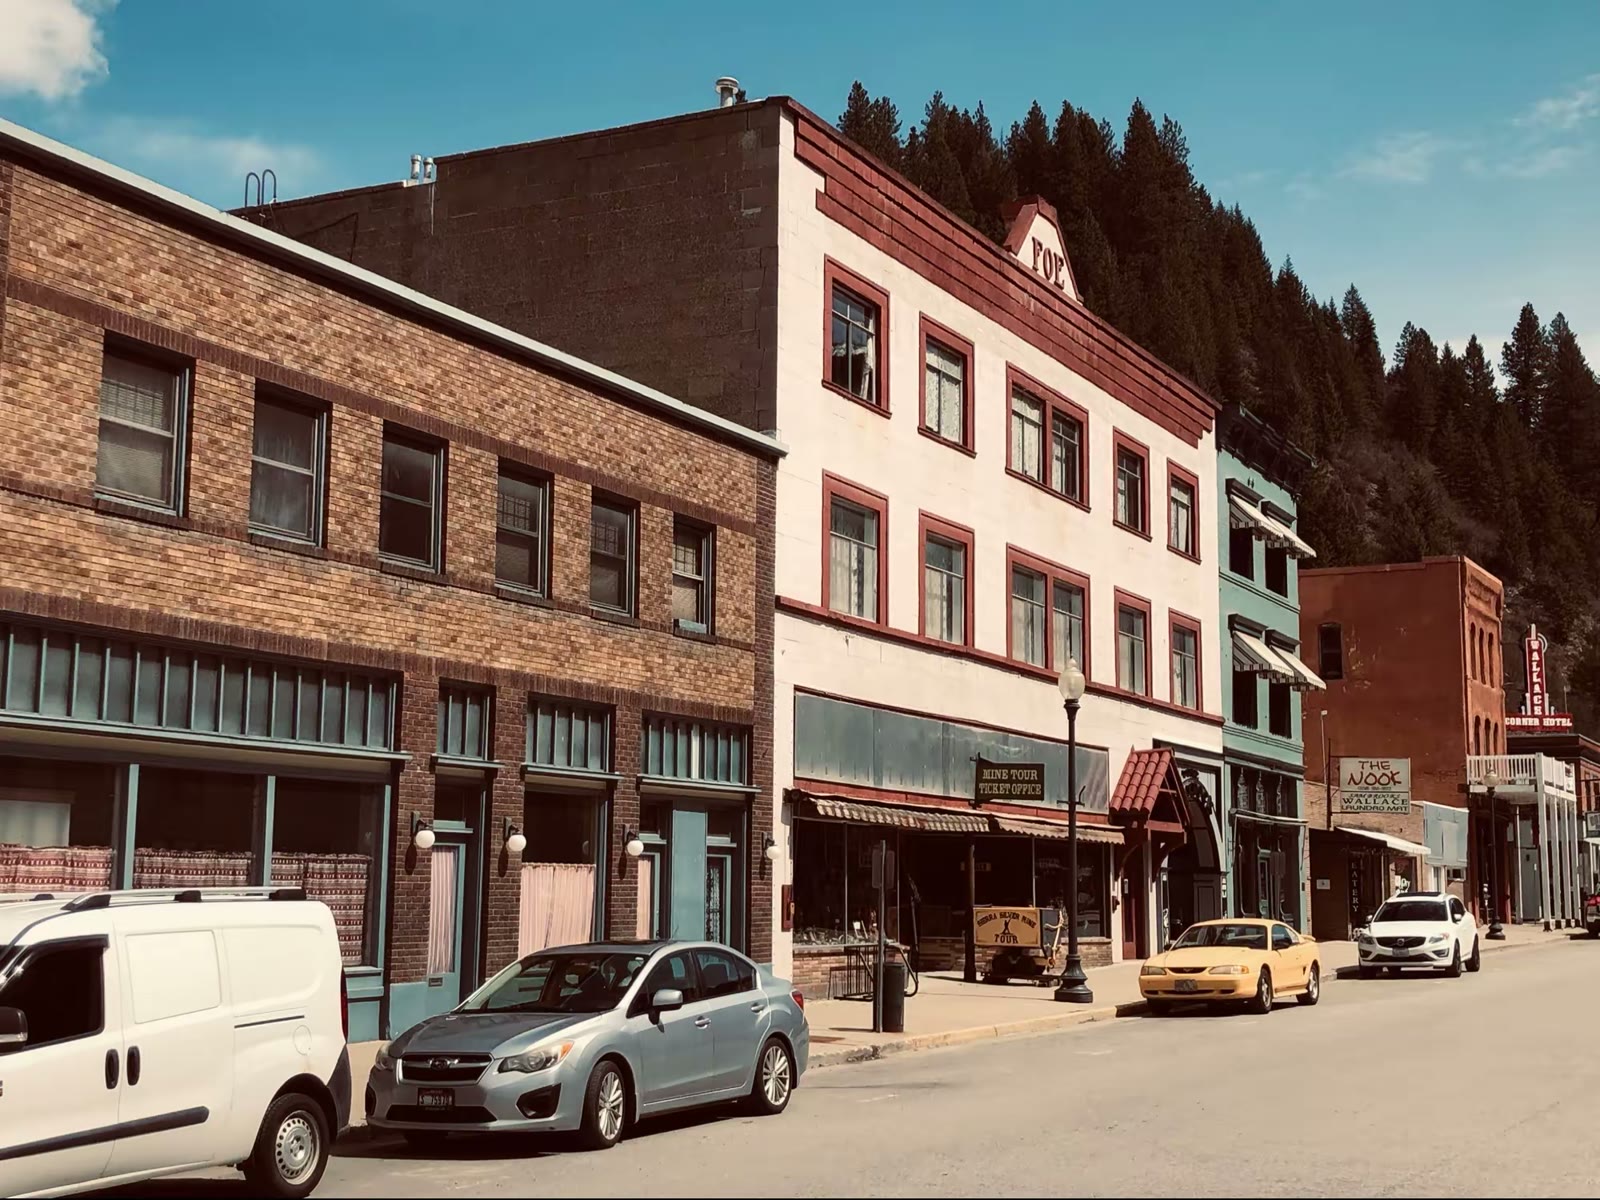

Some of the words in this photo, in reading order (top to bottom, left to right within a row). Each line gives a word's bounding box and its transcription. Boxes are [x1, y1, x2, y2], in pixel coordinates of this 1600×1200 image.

[1032, 236, 1064, 290] FOE
[1530, 640, 1543, 715] WALLACE
[1505, 717, 1540, 726] CORNER
[1543, 718, 1573, 727] HOTEL
[1358, 760, 1391, 771] THE
[982, 769, 1009, 780] MINE
[1010, 769, 1038, 780] TOUR
[1347, 770, 1402, 786] NOOK
[979, 782, 1010, 795] TICKET
[1011, 783, 1042, 795] OFFICE
[1342, 798, 1408, 806] WALLACE
[1351, 862, 1359, 912] EATERY
[999, 911, 1020, 920] SILVER
[994, 934, 1019, 944] TOUR
